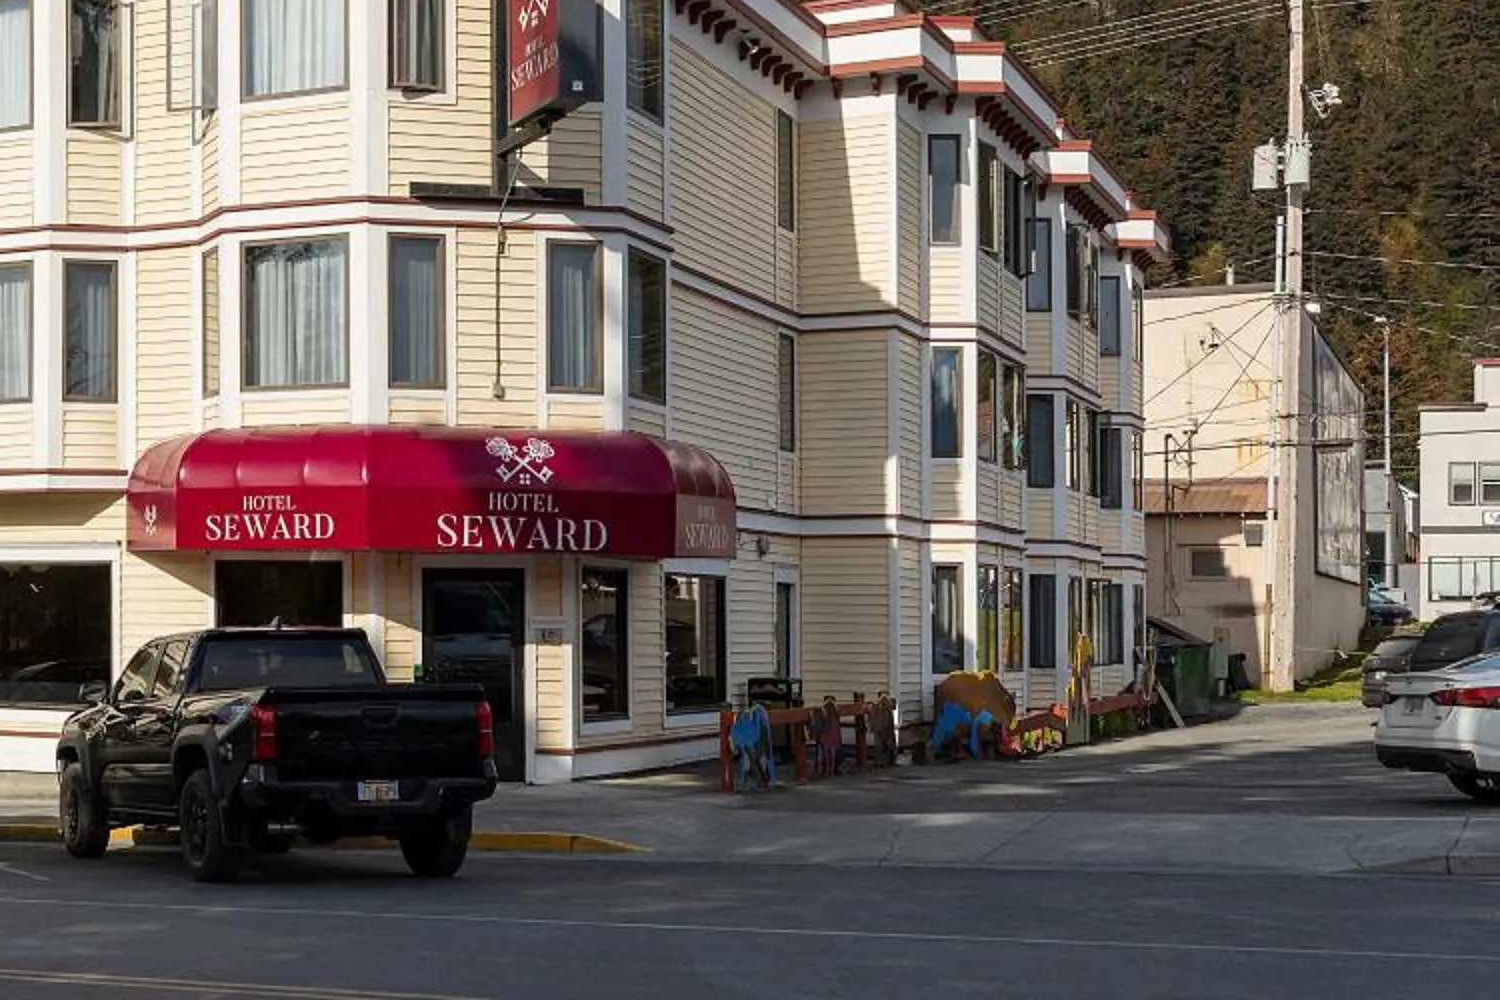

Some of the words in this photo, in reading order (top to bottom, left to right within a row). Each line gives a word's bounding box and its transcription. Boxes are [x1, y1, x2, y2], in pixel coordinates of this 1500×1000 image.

[242, 494, 297, 511] HOTEL
[488, 491, 559, 513] HOTEL
[205, 513, 335, 541] SEWARD
[436, 513, 607, 551] SEWARD
